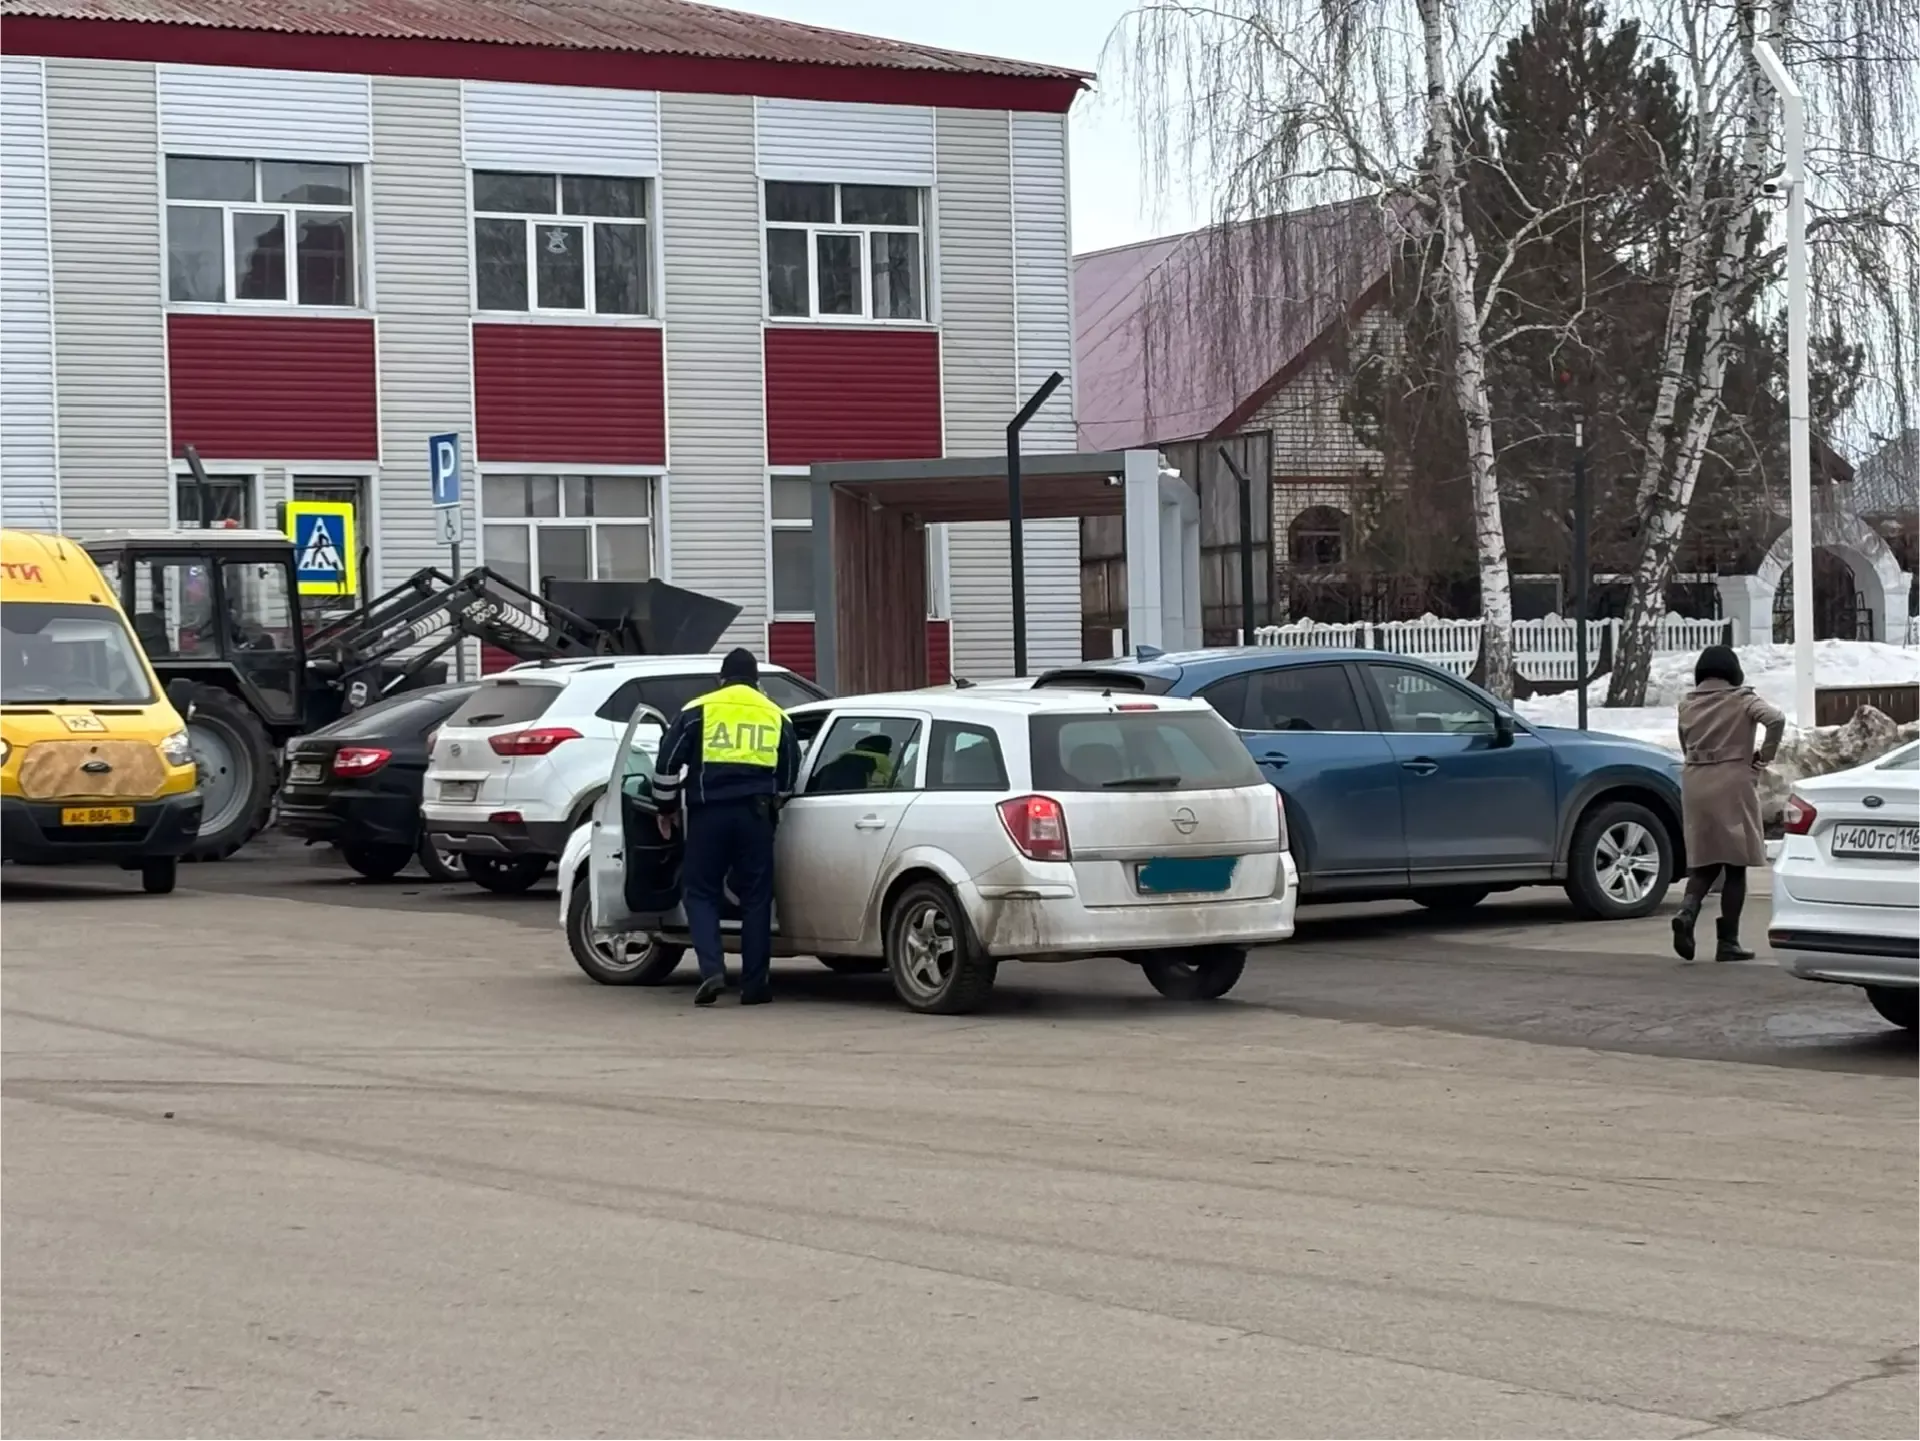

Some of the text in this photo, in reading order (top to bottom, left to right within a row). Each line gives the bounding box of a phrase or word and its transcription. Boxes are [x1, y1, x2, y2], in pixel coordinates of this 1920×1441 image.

[437, 441, 455, 498] P
[1, 562, 43, 583] ТИ
[708, 722, 777, 752] ДПС
